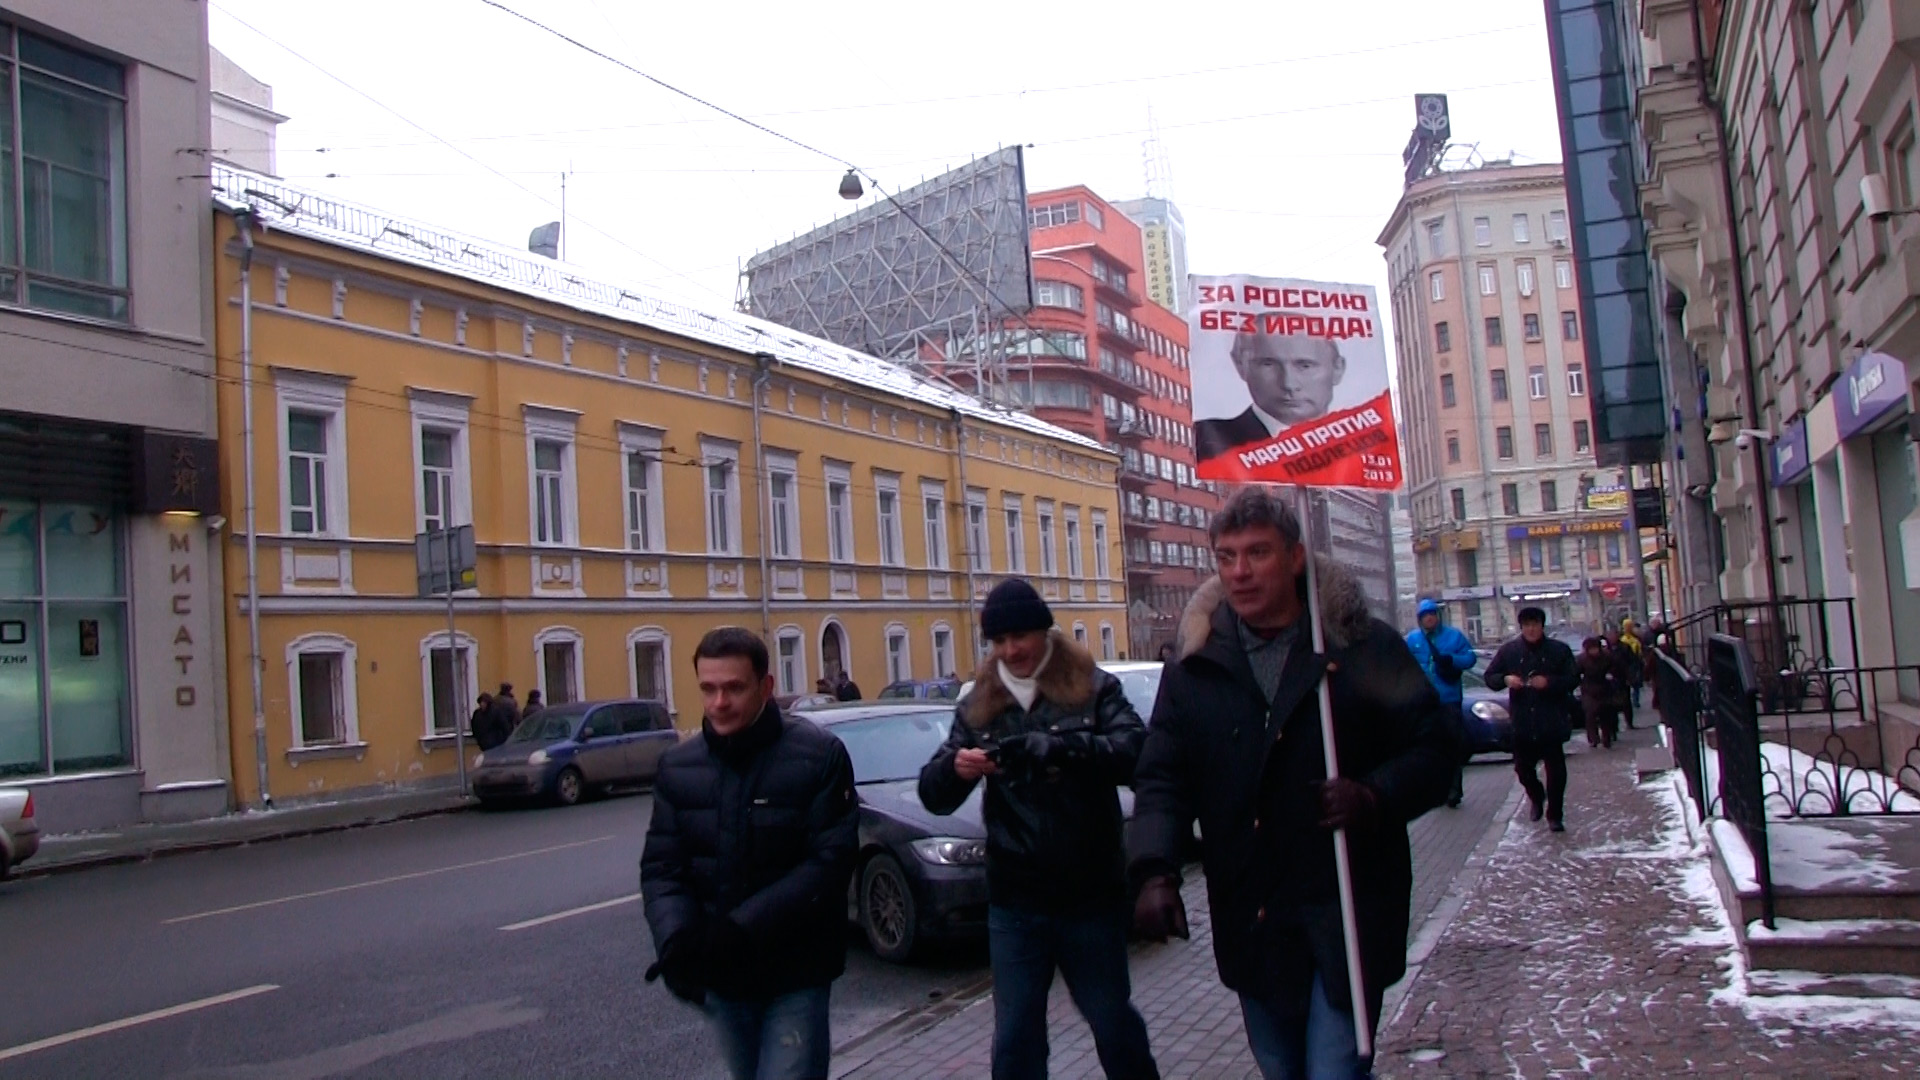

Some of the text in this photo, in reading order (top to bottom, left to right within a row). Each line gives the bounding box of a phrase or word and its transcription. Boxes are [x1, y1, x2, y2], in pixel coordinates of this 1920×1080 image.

[1198, 285, 1368, 312] ЗА РОССИЮ
[1200, 310, 1373, 340] БЕЗ ИРОДА!
[1239, 407, 1383, 469] МАРШ ПРОТИВ
[1361, 453, 1392, 467] 13.01
[1363, 468, 1393, 481] 2013
[1528, 524, 1562, 536] БАНК
[169, 533, 195, 705] МИСАТО
